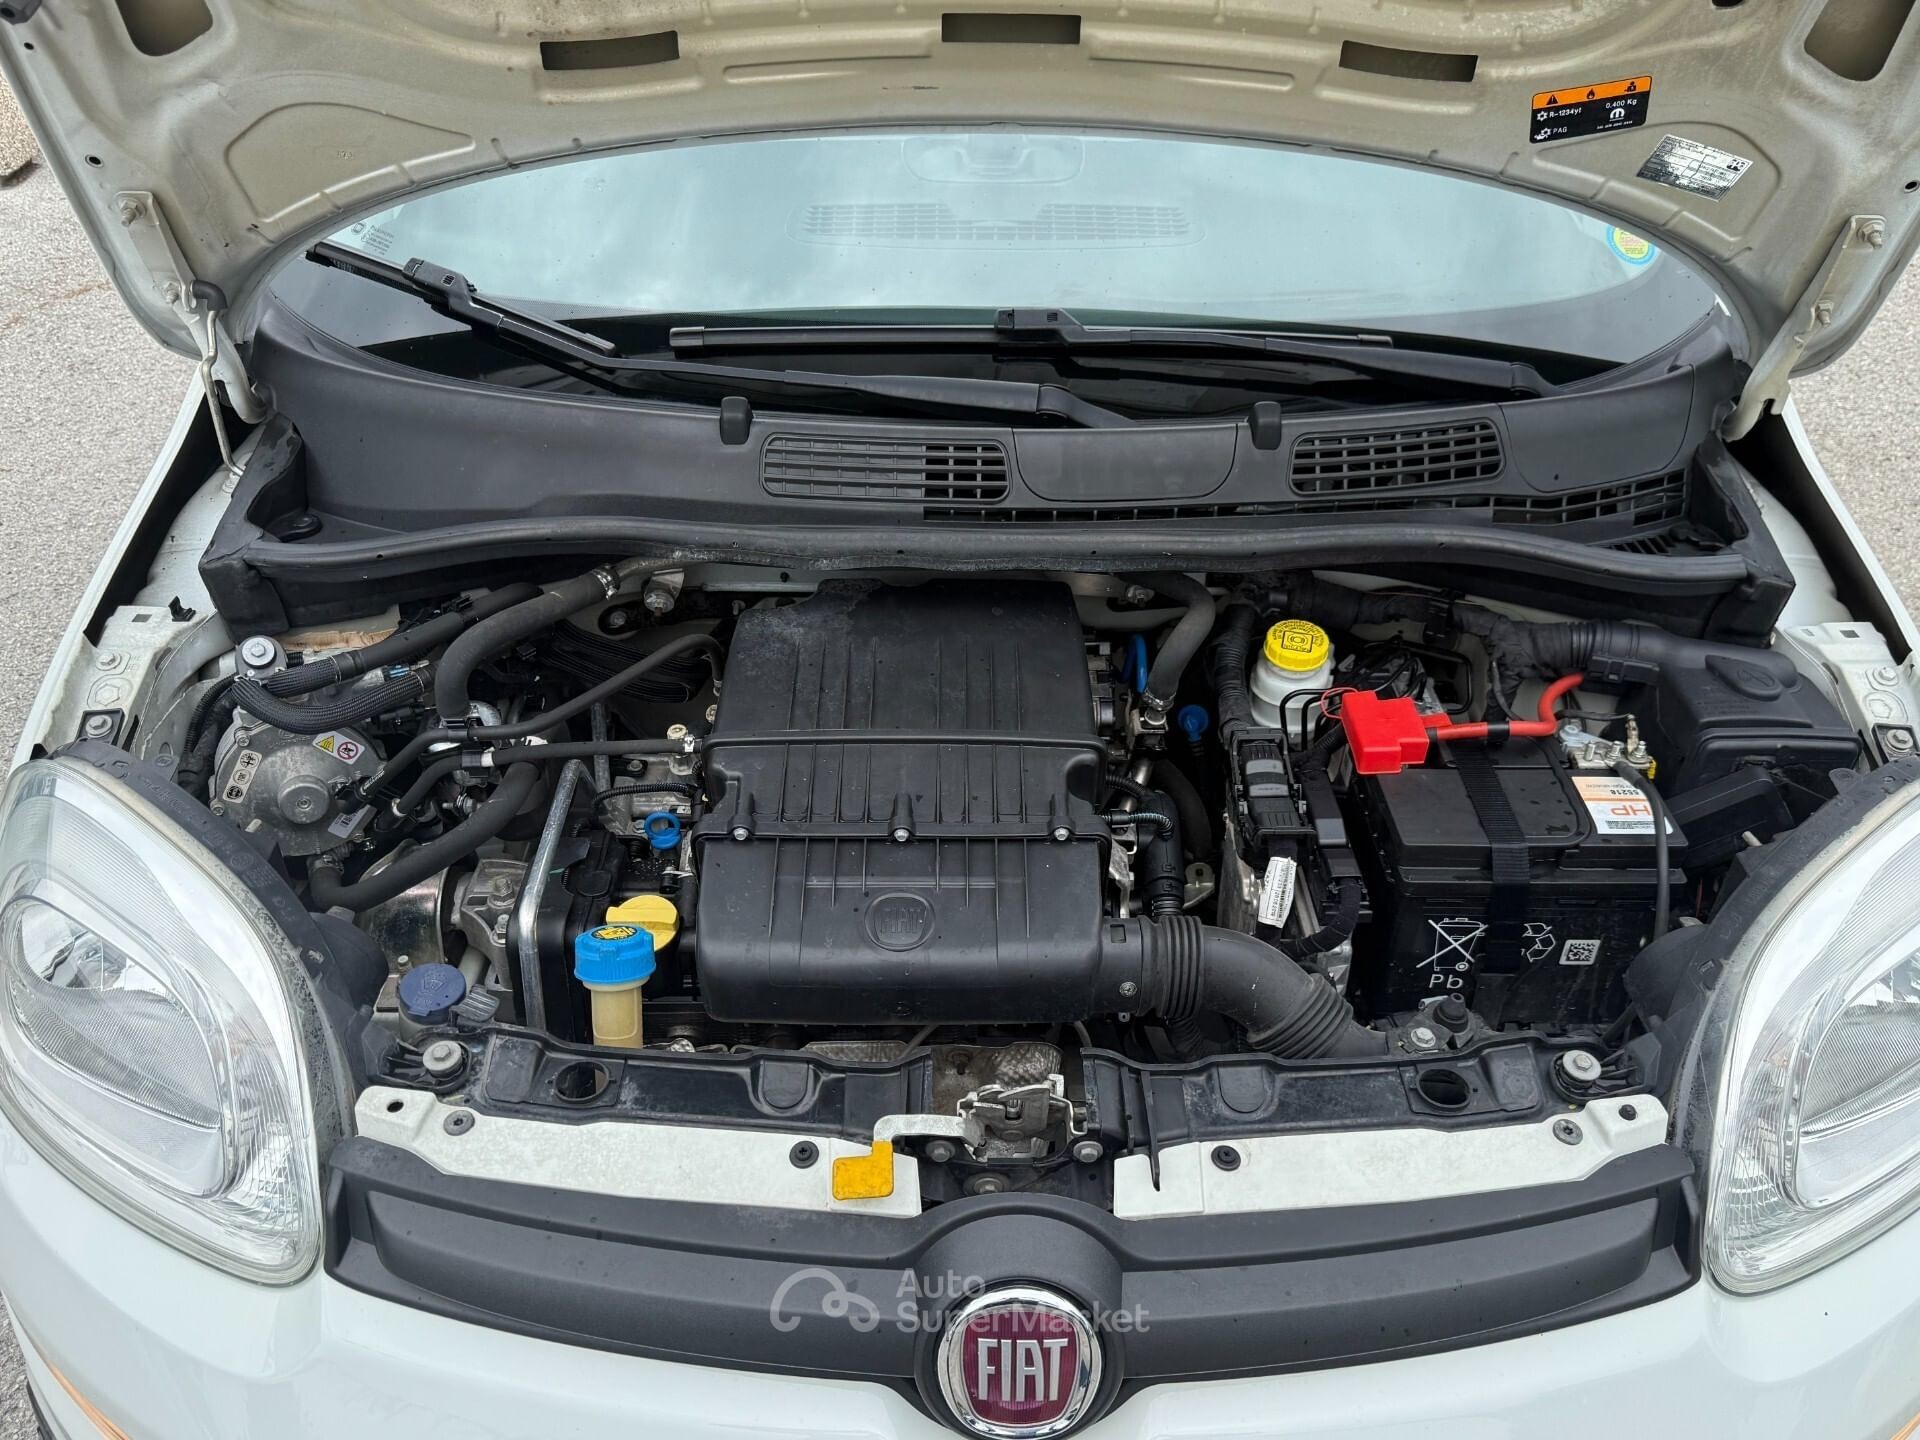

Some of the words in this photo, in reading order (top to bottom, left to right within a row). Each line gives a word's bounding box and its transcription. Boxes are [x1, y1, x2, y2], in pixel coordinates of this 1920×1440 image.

[1605, 100, 1625, 109] 0.400
[1627, 98, 1638, 106] Kg
[1549, 107, 1582, 118] R-1234yf
[1552, 126, 1568, 134] PAG
[1610, 804, 1652, 816] HP
[880, 907, 922, 934] FIAT
[1428, 974, 1464, 989] Pb
[976, 1337, 1069, 1402] FIAT
